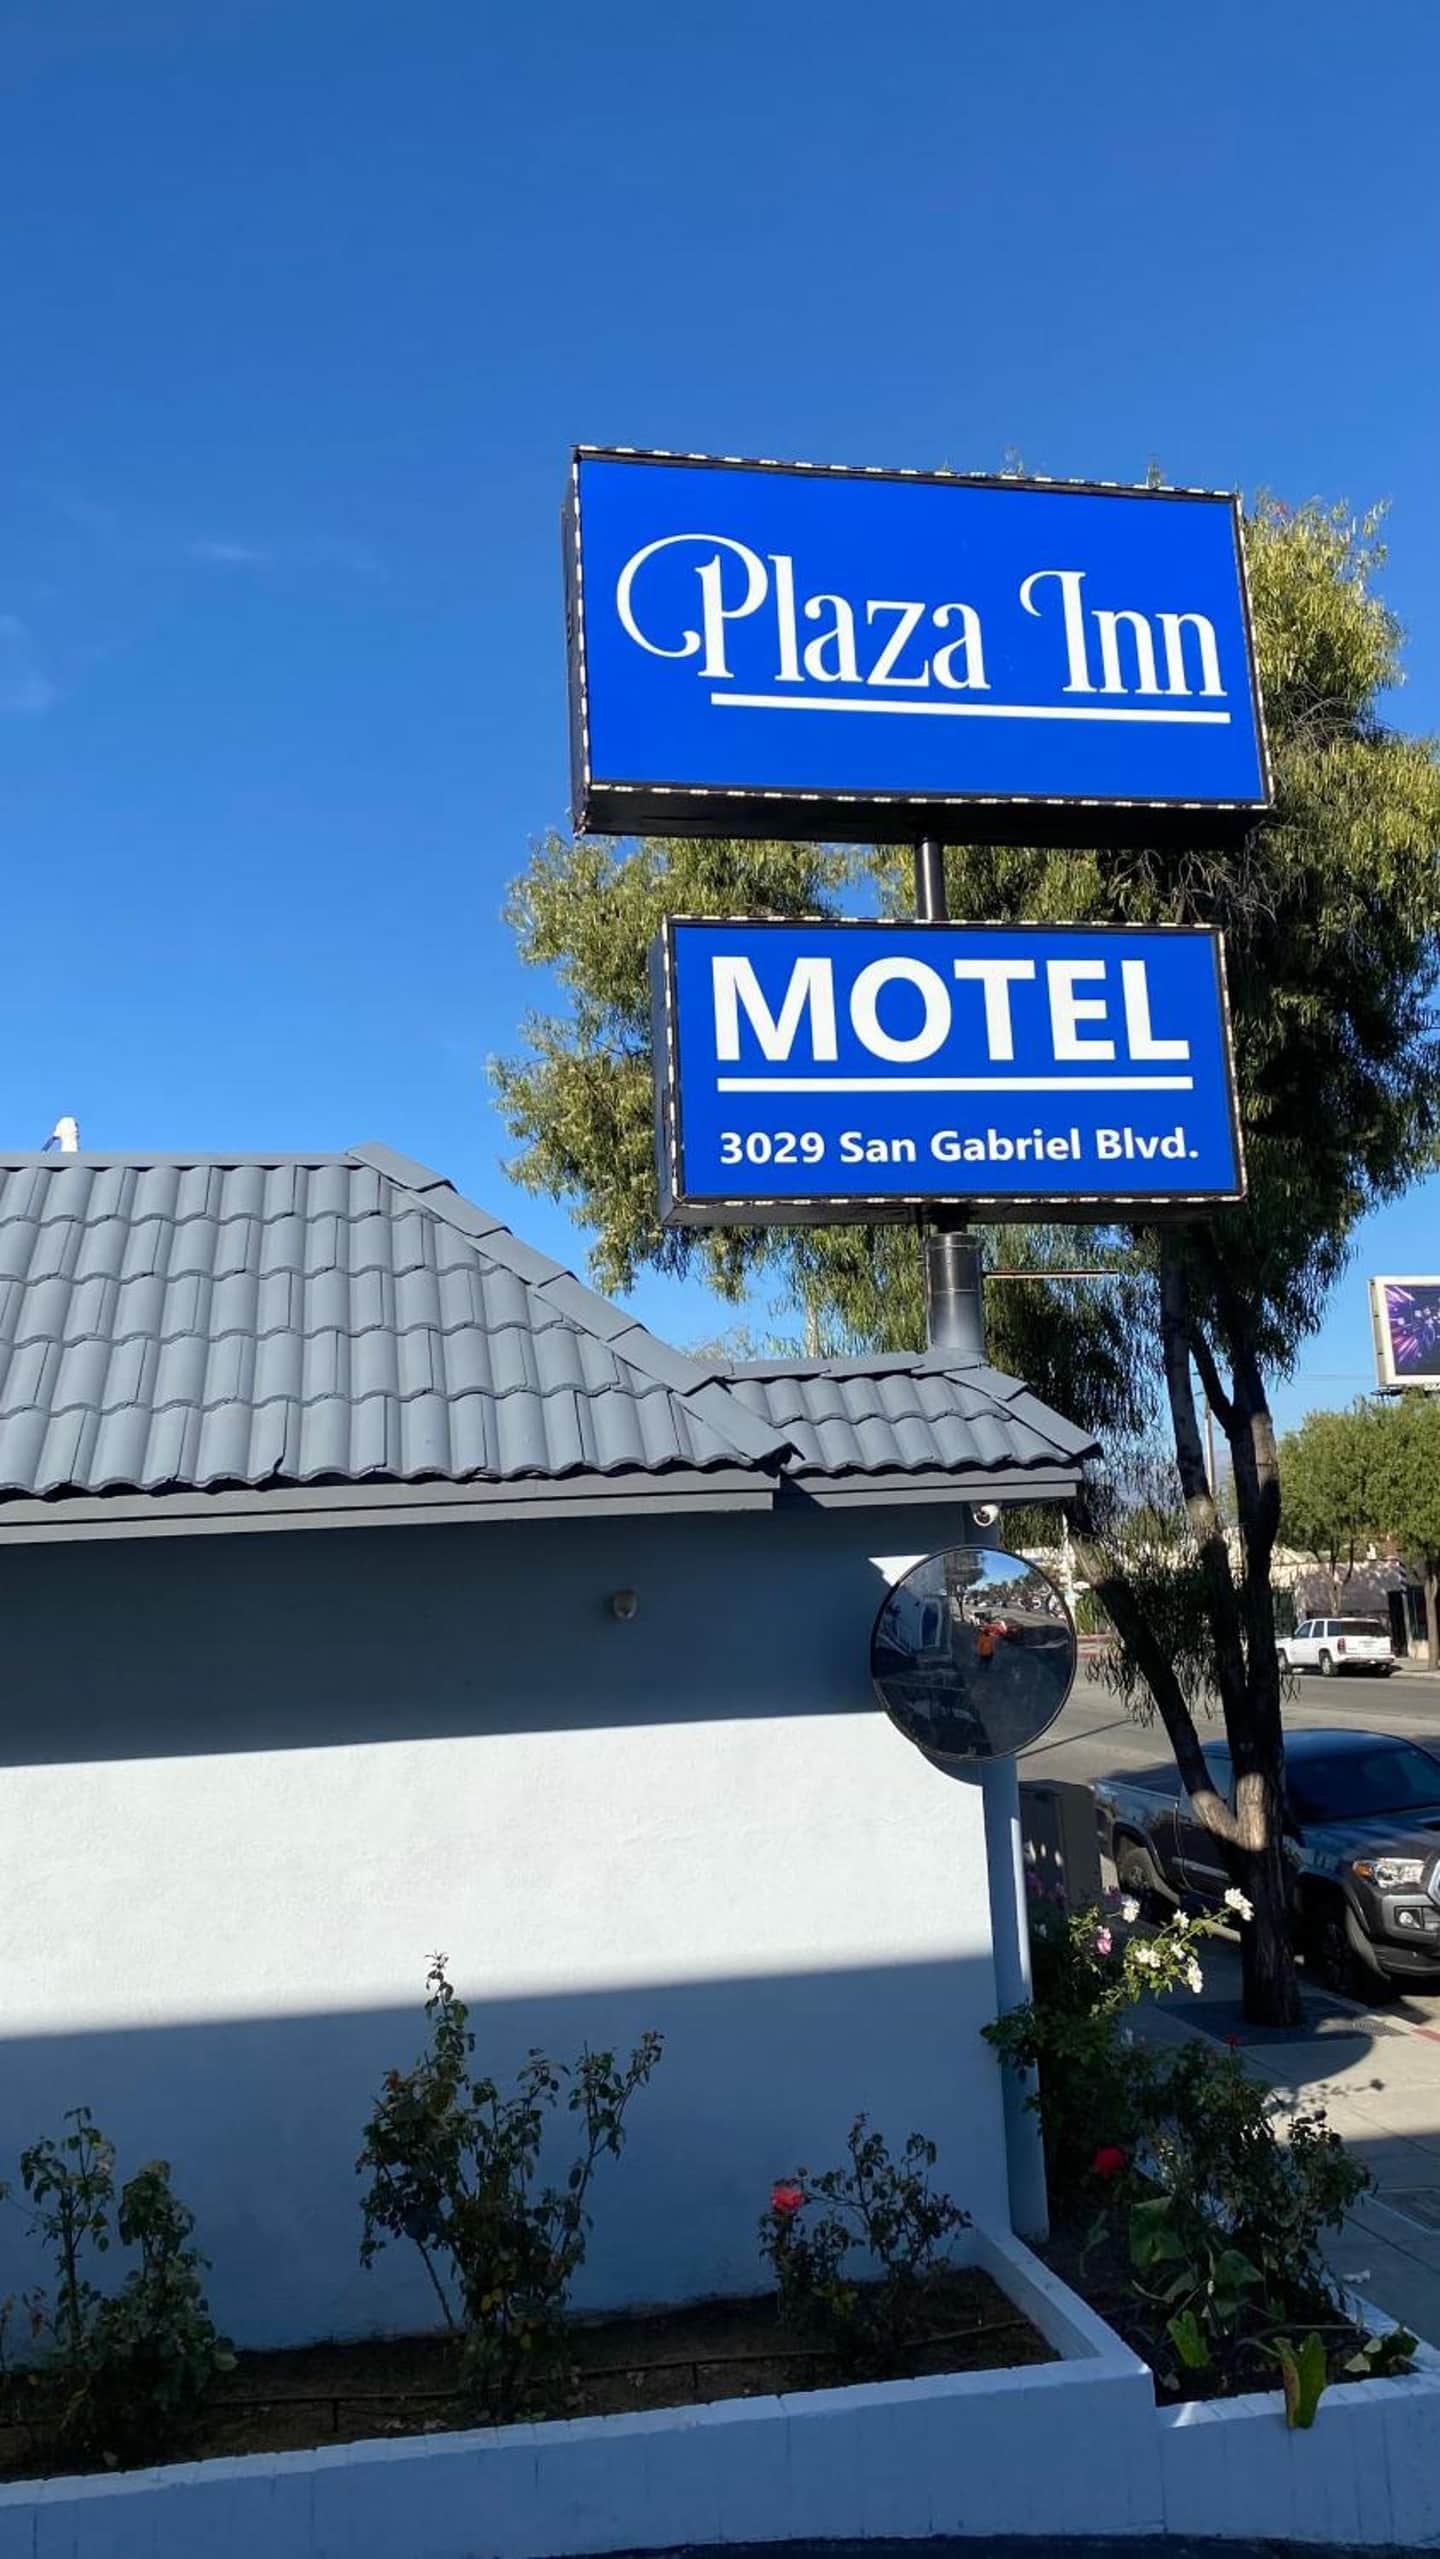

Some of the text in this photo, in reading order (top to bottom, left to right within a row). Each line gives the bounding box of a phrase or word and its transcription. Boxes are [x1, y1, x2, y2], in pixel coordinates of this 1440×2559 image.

[616, 533, 1228, 696] Plaza Inn
[711, 956, 1191, 1063] MOTEL
[720, 1127, 1199, 1164] 3029 San Gabriel Blvd.
